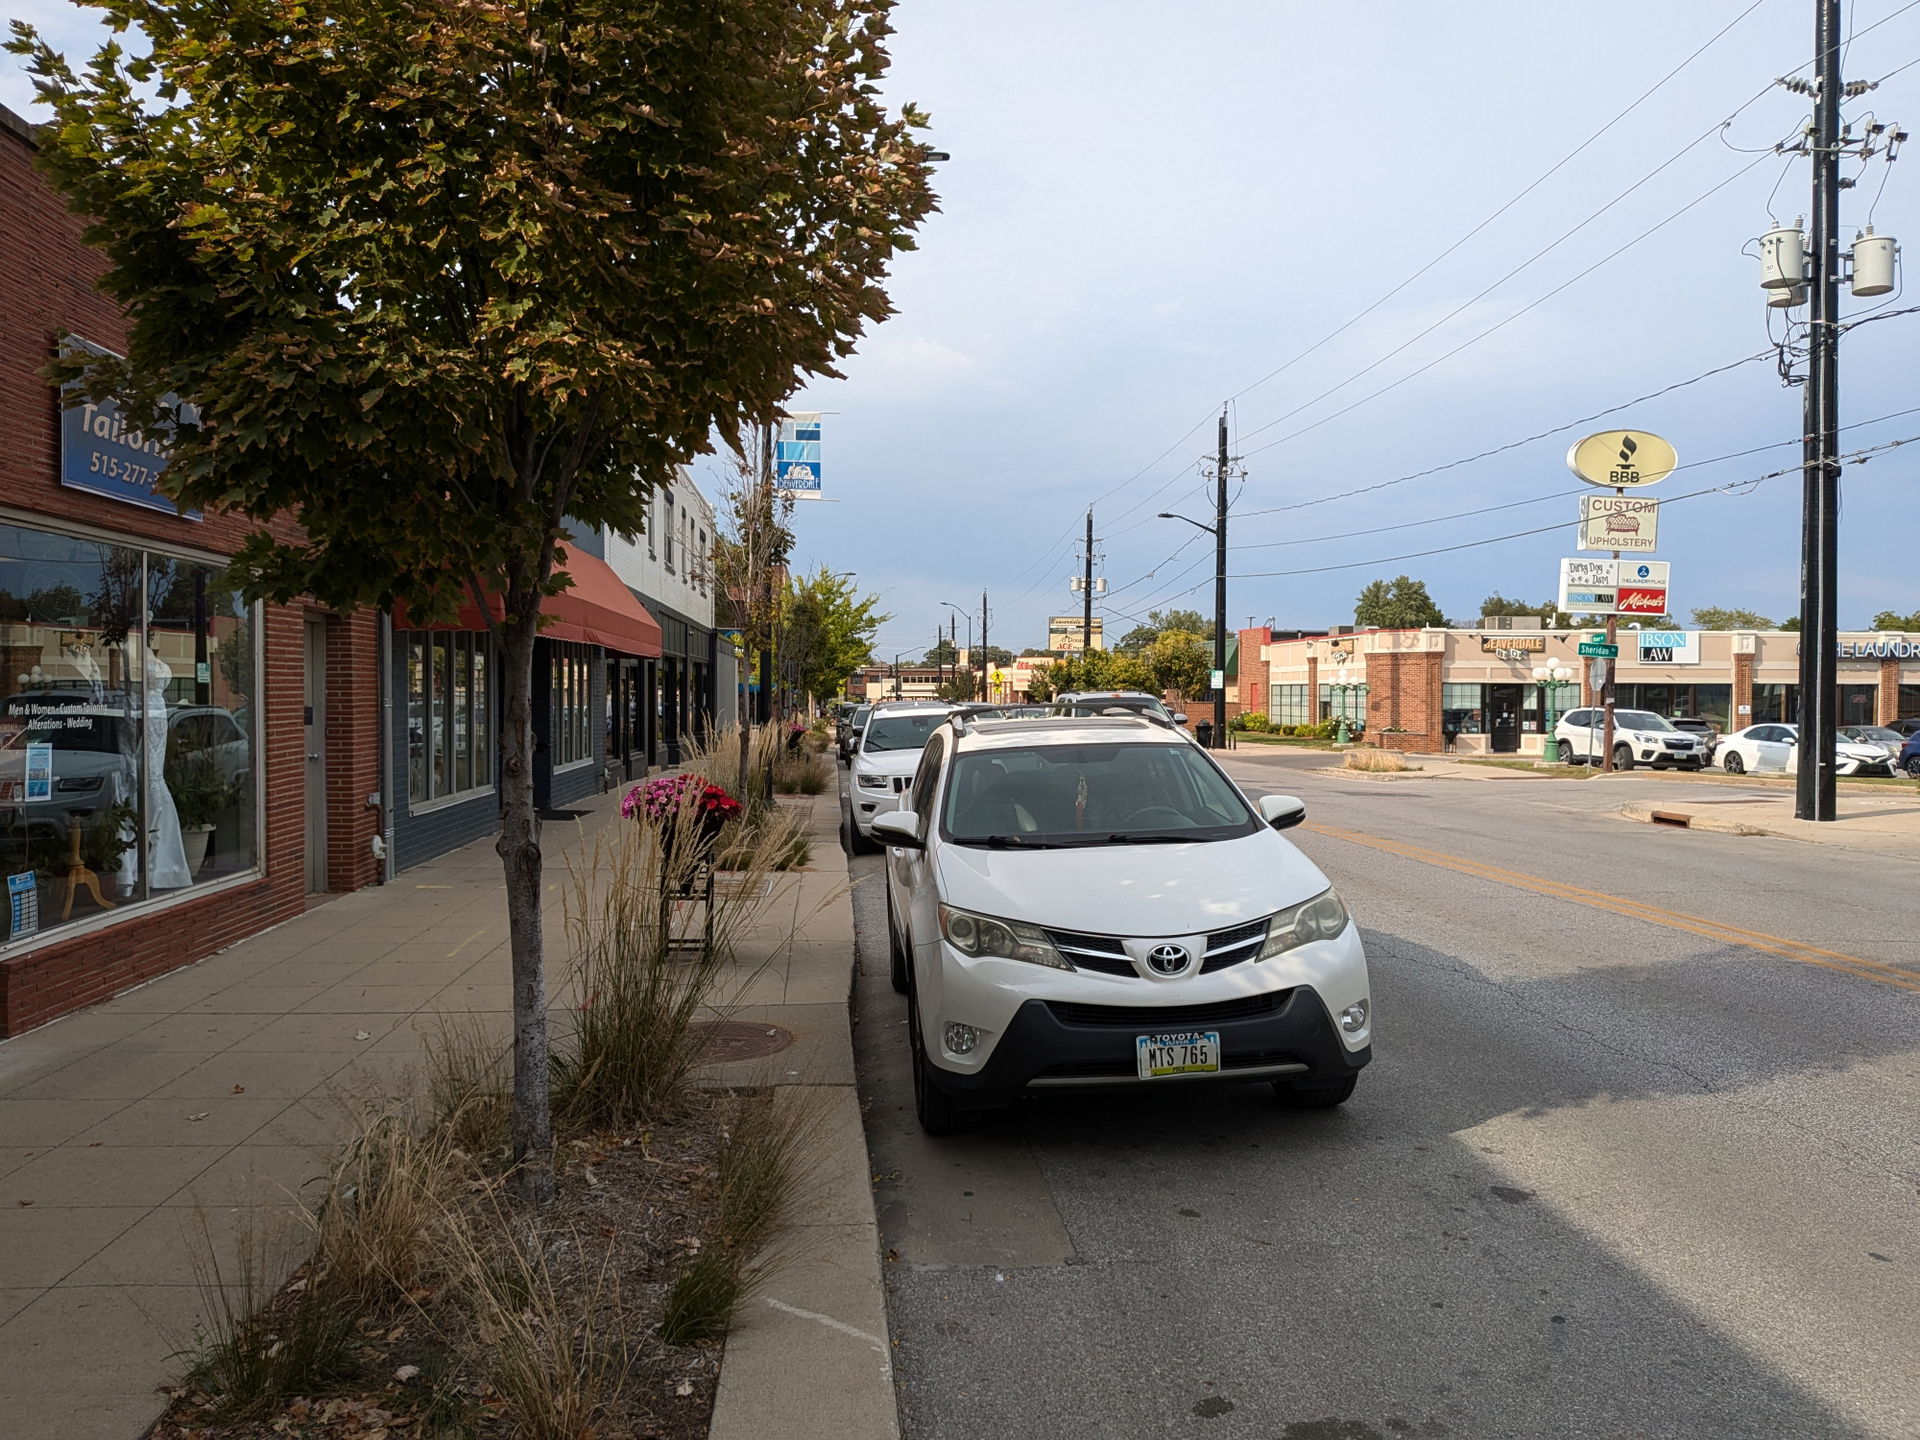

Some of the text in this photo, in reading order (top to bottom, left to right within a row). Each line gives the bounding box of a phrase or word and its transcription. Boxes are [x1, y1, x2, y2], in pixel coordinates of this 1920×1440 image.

[1610, 471, 1640, 483] BBB
[1592, 499, 1655, 514] CUSTOM
[1589, 536, 1654, 548] UPHOLSTERY
[1569, 562, 1603, 575] Dirty Dog
[1596, 594, 1613, 603] LAW
[1640, 633, 1685, 646] IBSON
[1581, 645, 1609, 655] Sheridan
[1640, 647, 1671, 661] LAW
[8, 703, 23, 717] Men
[25, 703, 30, 714] &
[31, 703, 55, 715] Women
[59, 703, 83, 714] Custom
[28, 718, 62, 730] Alterations
[67, 716, 93, 729] Wedding
[1155, 1033, 1200, 1042] TOYOTA
[1149, 1045, 1207, 1068] MTS 765
